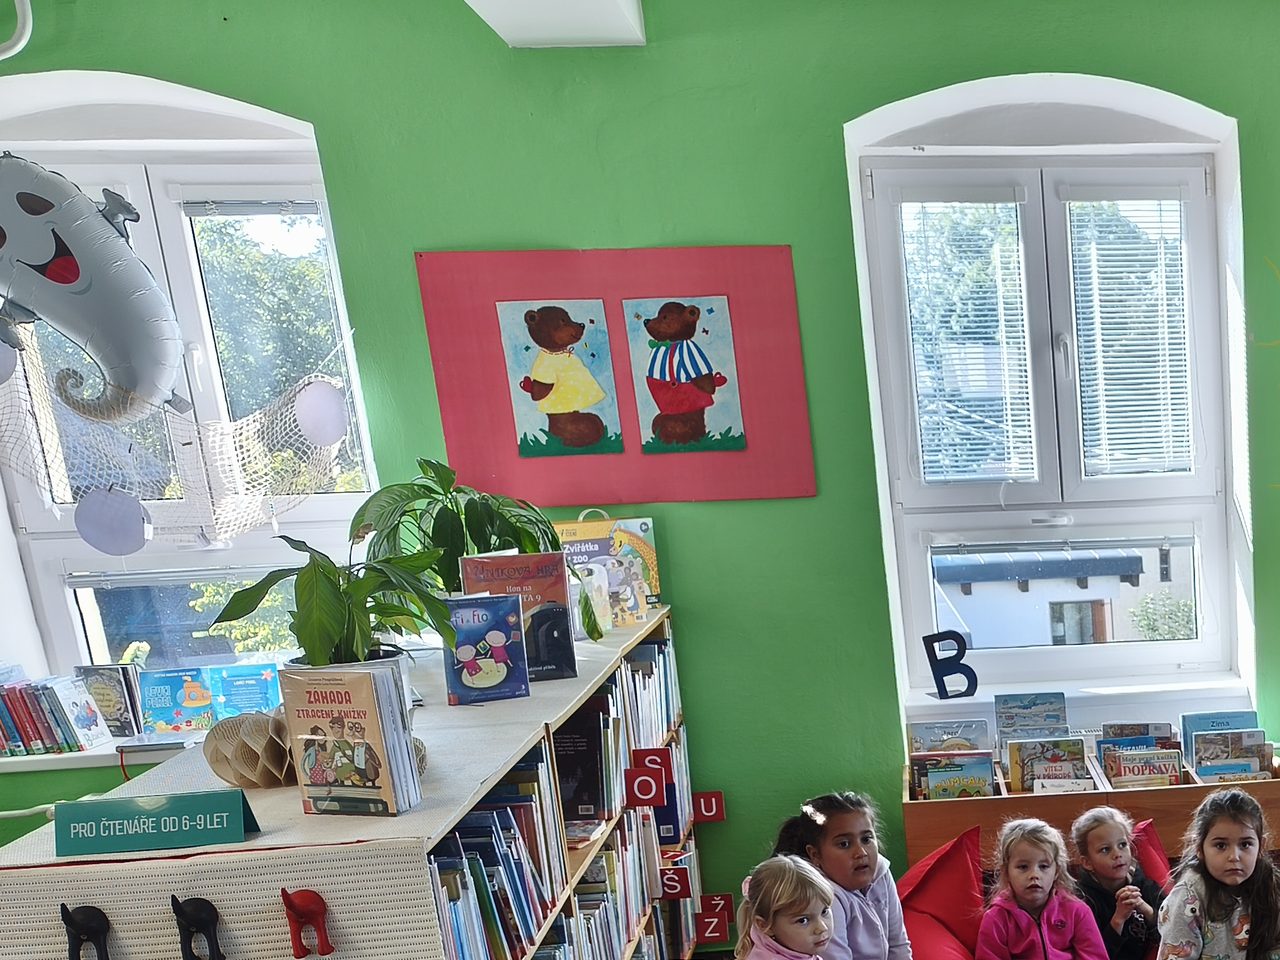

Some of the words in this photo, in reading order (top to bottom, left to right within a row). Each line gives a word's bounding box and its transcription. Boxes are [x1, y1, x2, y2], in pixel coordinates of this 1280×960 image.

[563, 542, 599, 553] Zvířátka
[922, 629, 978, 699] B
[305, 687, 352, 704] ZÁHADA
[1210, 720, 1230, 728] Zima
[1121, 762, 1178, 777] DOPRAVA
[633, 775, 656, 799] O
[700, 797, 716, 816] U
[70, 821, 96, 838] PRO
[100, 815, 157, 837] ČTENÁŘE
[161, 816, 179, 832] OD
[182, 814, 204, 830] 6-9
[206, 812, 229, 829] LET
[663, 870, 681, 893] Š
[704, 918, 720, 937] Z
